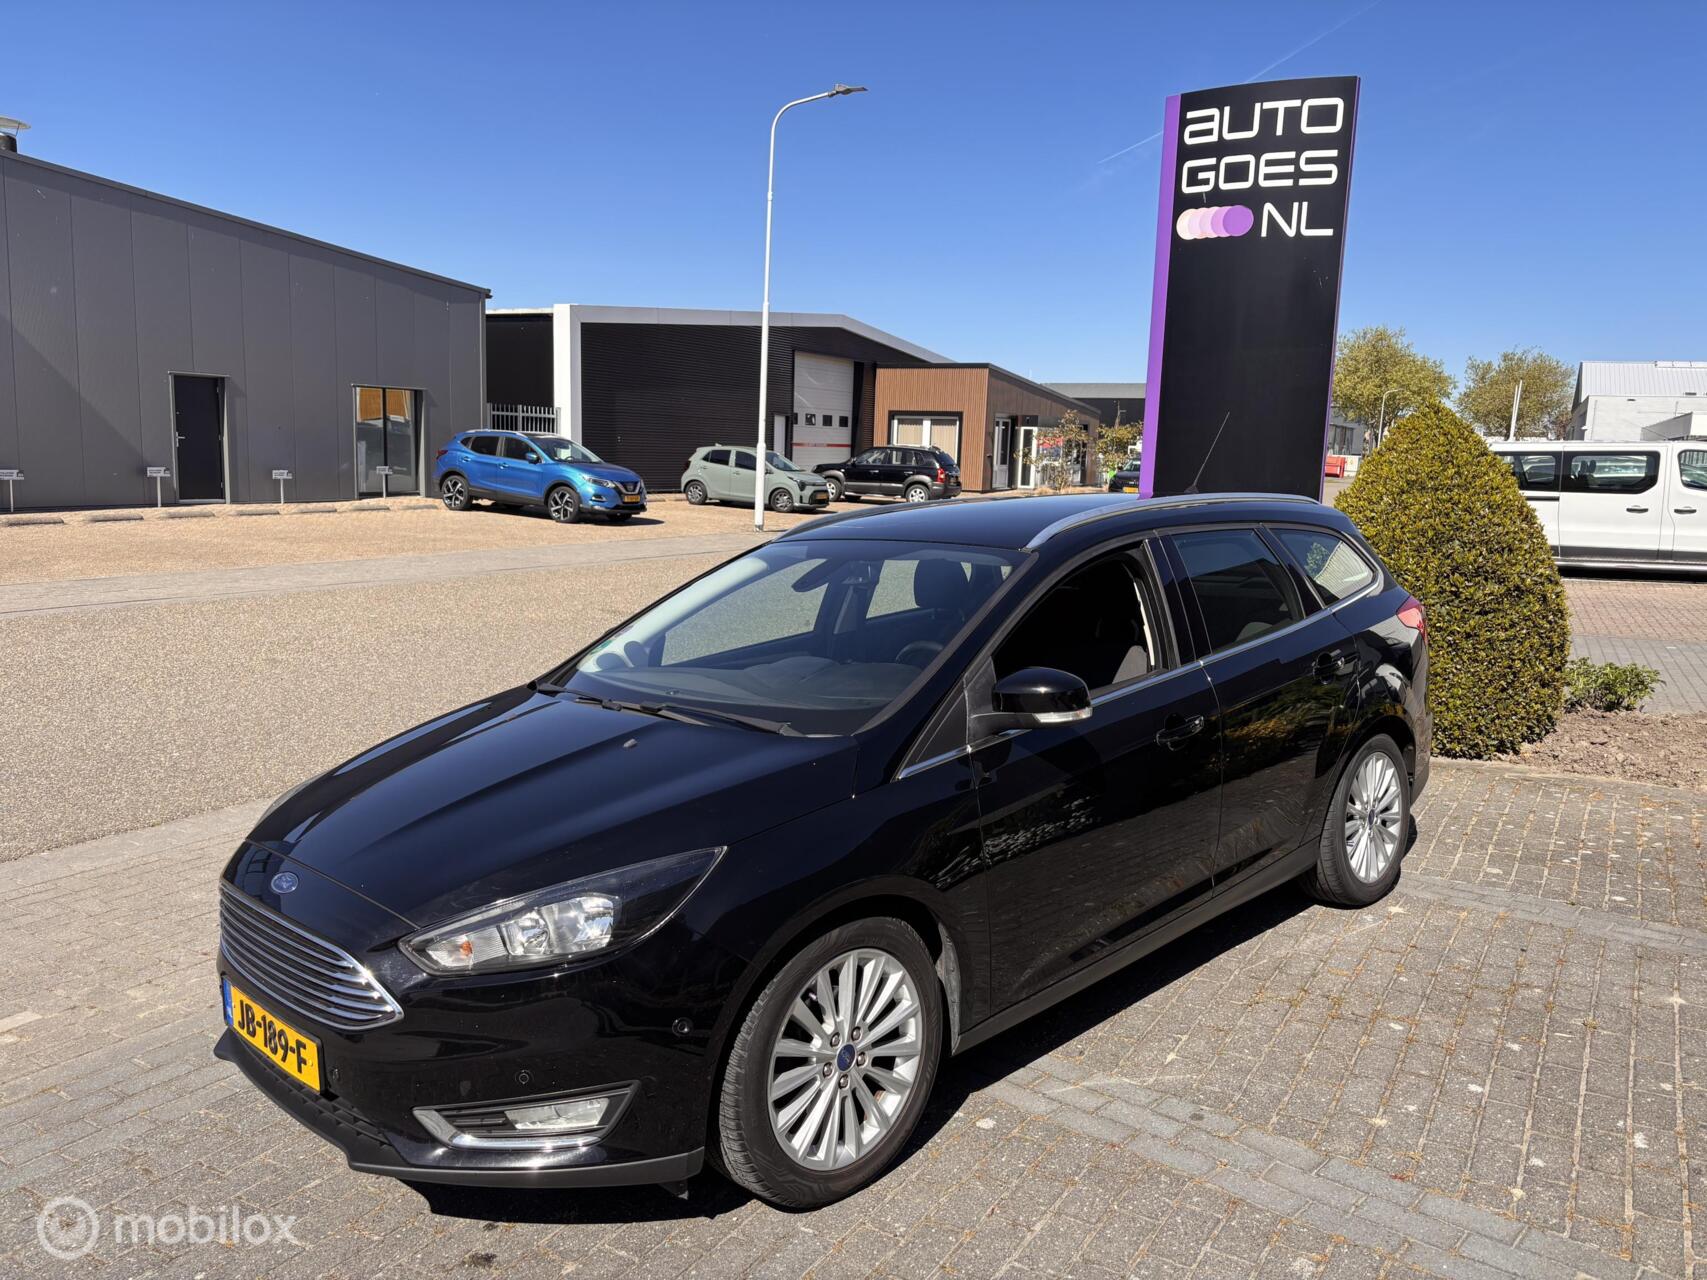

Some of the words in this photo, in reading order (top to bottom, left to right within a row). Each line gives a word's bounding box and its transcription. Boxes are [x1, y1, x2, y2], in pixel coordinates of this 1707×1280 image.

[1181, 149, 1338, 194] GOES
[1261, 201, 1334, 238] NL
[238, 999, 307, 1074] JB-189-F
